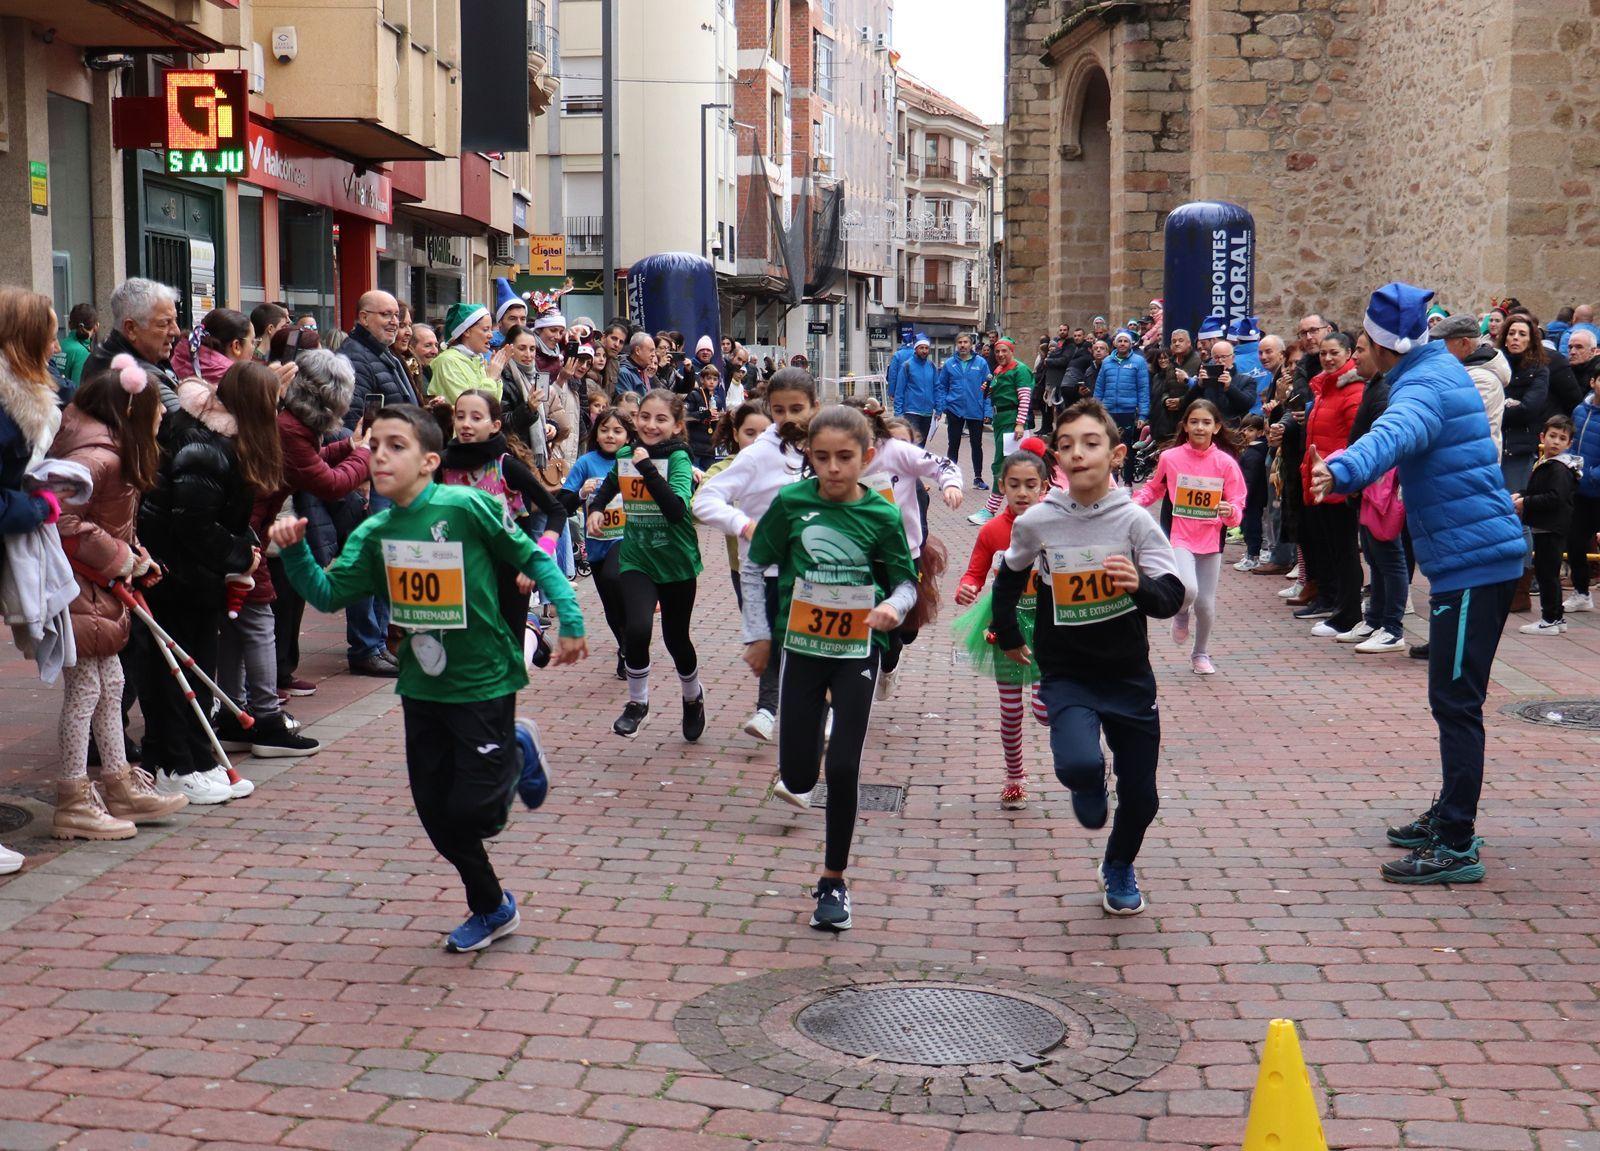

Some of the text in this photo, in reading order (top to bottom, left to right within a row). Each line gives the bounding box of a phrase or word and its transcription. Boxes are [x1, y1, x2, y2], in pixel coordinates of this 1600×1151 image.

[531, 243, 562, 256] digital
[543, 259, 551, 272] 1
[1212, 229, 1226, 318] DEPORTES
[1229, 230, 1247, 326] MORAL
[628, 275, 640, 325] RAL
[1187, 491, 1211, 507] 168
[398, 571, 440, 602] 190
[1069, 572, 1116, 602] 210
[404, 609, 411, 620] DE
[412, 609, 462, 621] EXTREMADURA
[1059, 597, 1133, 619] JUNTA DE EXTREMADURA
[808, 608, 853, 637] 378
[789, 635, 865, 654] JUNTA DE EXTREMADURA
